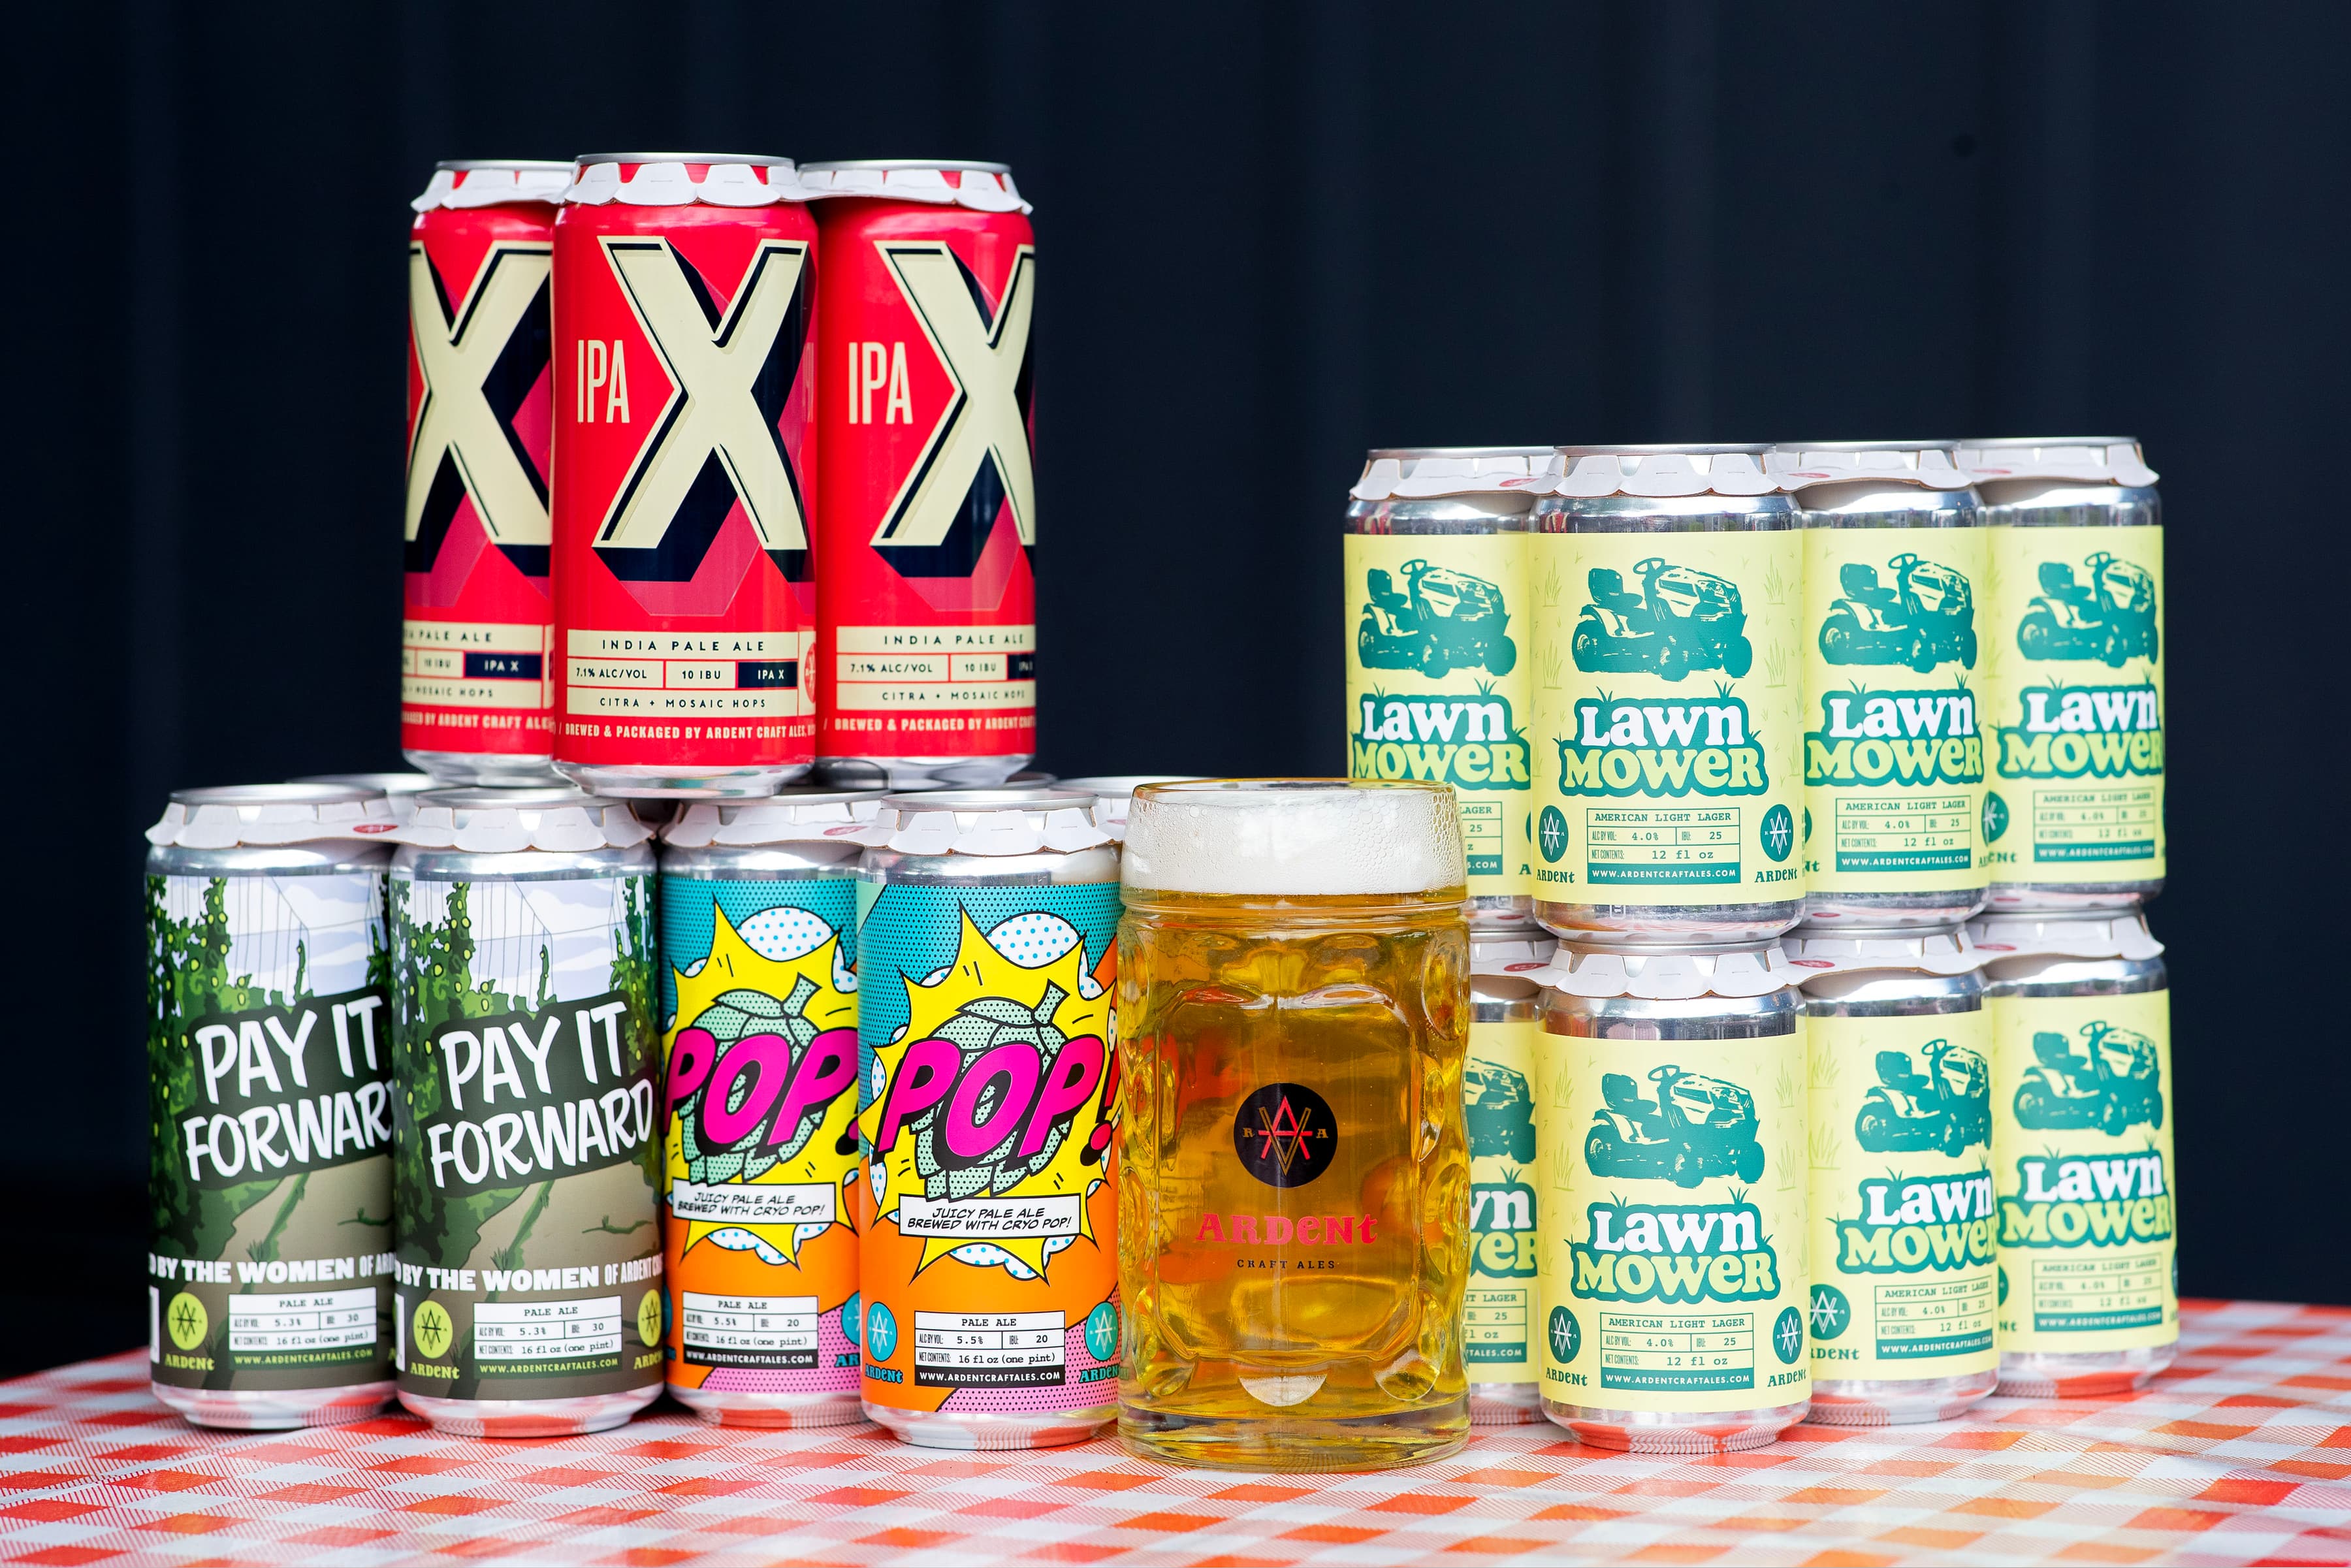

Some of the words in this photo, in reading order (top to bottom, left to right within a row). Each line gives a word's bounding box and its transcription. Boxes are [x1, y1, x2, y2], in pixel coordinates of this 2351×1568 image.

[577, 340, 630, 424] IPA
[848, 342, 913, 425] IPA
[592, 236, 810, 549] X
[870, 241, 1035, 547] X
[419, 630, 450, 641] PALE
[461, 632, 492, 643] ALE
[884, 635, 942, 645] INDIA
[955, 635, 995, 645] PALE
[1004, 633, 1024, 645] ALE
[602, 639, 656, 650] INDIA
[671, 641, 720, 651] PALE
[733, 641, 764, 651] ALE
[485, 660, 505, 671] IPA
[511, 661, 519, 672] X
[850, 664, 876, 673] 7.1%
[880, 664, 933, 673] ALC/VOL
[965, 663, 976, 673] 10
[980, 663, 997, 673] IBU
[575, 667, 595, 678] 7.1%
[599, 668, 647, 679] ALC/VOL
[681, 670, 694, 680] 10
[699, 670, 721, 680] IBU
[758, 669, 775, 680] IPA
[778, 669, 784, 680] X
[459, 688, 493, 698] HOPS
[882, 692, 926, 701] CITRA
[950, 691, 999, 700] MOSAIC
[600, 697, 639, 707] CITRA
[665, 699, 723, 709] MOSAIC
[733, 699, 766, 708] HOPS
[1829, 696, 1974, 738] Lawn
[2026, 690, 2158, 733] Lawn
[438, 712, 479, 729] ARDENT
[482, 714, 522, 729] CRAFT
[835, 718, 882, 731] BREWED
[887, 718, 897, 731] &
[901, 718, 964, 731] PACKAGED
[968, 717, 982, 731] BY
[985, 716, 1019, 730] ARDENT
[1362, 701, 1508, 742] Lawn
[1580, 705, 1744, 746] Lawn
[565, 722, 600, 737] BREWED
[603, 725, 613, 738] &
[616, 725, 680, 739] PACKAGED
[684, 727, 701, 739] BY
[706, 726, 753, 739] ARDENT
[757, 726, 787, 738] CRAFT
[1846, 801, 1900, 811] AMERICAN
[1907, 801, 1937, 810] LIGHT
[1942, 800, 1966, 809] LAGER
[1595, 812, 1648, 823] AMERICAN
[1655, 812, 1691, 822] LIGHT
[1698, 812, 1731, 822] LAGER
[1631, 831, 1659, 841] 4.0%
[1709, 831, 1722, 840] 25
[1652, 850, 1666, 860] 12
[1676, 850, 1691, 859] fl
[1842, 855, 1968, 867] WWW.ARDENTCRAFTALES.COM
[1591, 869, 1736, 879] WWW.ARDENTCRAFTALES.COM
[195, 1009, 318, 1104] PAY
[332, 995, 383, 1078] IT
[438, 1016, 562, 1111] PAY
[575, 1001, 627, 1084] IT
[663, 1027, 858, 1146] POP
[874, 1034, 1121, 1166] POP!
[427, 1078, 653, 1189] FORWARD
[2024, 1156, 2163, 1202] Lawn
[694, 1191, 729, 1202] JUICY
[731, 1194, 763, 1204] PALE
[769, 1194, 795, 1204] ALE
[1866, 1176, 1992, 1225] Lawn
[677, 1200, 717, 1213] BREWED
[720, 1204, 750, 1215] WITH
[753, 1205, 789, 1216] CRYO
[792, 1204, 825, 1215] POP!
[932, 1208, 975, 1219] JUICY
[978, 1209, 1014, 1219] PALE
[1019, 1208, 1045, 1217] ALE
[907, 1217, 961, 1230] BREWED
[965, 1219, 1000, 1231] WITH
[1002, 1219, 1040, 1230] CRYO
[1042, 1216, 1072, 1229] POP!
[1593, 1211, 1758, 1253] Lawn
[157, 1255, 179, 1280] BY
[181, 1259, 232, 1283] THE
[236, 1257, 355, 1284] WOMEN
[359, 1255, 374, 1277] OF
[1237, 1259, 1287, 1269] CRAFT
[1297, 1260, 1335, 1269] ALES
[402, 1264, 424, 1287] BY
[426, 1267, 476, 1291] THE
[481, 1266, 600, 1291] WOMEN
[604, 1264, 619, 1286] OF
[620, 1258, 653, 1283] ARDENT
[1885, 1288, 1936, 1299] AMERICAN
[1942, 1285, 1968, 1296] LIGHT
[279, 1299, 306, 1308] PALE
[313, 1297, 333, 1307] ALE
[718, 1300, 742, 1309] PALE
[1483, 1294, 1517, 1303] LAGER
[524, 1308, 551, 1317] PALE
[558, 1306, 578, 1315] ALE
[592, 1322, 604, 1332] 30
[787, 1319, 799, 1327] 20
[961, 1319, 989, 1327] PALE
[1608, 1319, 1663, 1328] AMERICAN
[1670, 1319, 1705, 1328] LIGHT
[1712, 1319, 1745, 1328] LAGER
[519, 1326, 546, 1336] 5.3%
[956, 1335, 983, 1345] 5.5%
[1036, 1334, 1048, 1343] 20
[1646, 1338, 1673, 1347] 4.0%
[1723, 1337, 1736, 1347] 25
[1881, 1335, 1991, 1354] WWW.ARDENTCRAFTALES.COM
[233, 1349, 373, 1366] WWW.ARDENTCRAFTALES.COM
[686, 1350, 813, 1364] WWW.ARDENTCRAFTALES.COM
[959, 1354, 970, 1364] 16
[972, 1354, 984, 1364] fl
[1001, 1354, 1024, 1366] (one
[1028, 1352, 1055, 1366] pint)
[1667, 1356, 1681, 1366] 12
[1690, 1356, 1705, 1366] fl
[479, 1358, 618, 1373] WWW.ARDENTCRAFTALES.COM
[920, 1371, 1061, 1383] WWW.ARDENTCRAFTALES.COM
[1605, 1374, 1750, 1385] WWW.ARDENTCRAFTALES.COM
